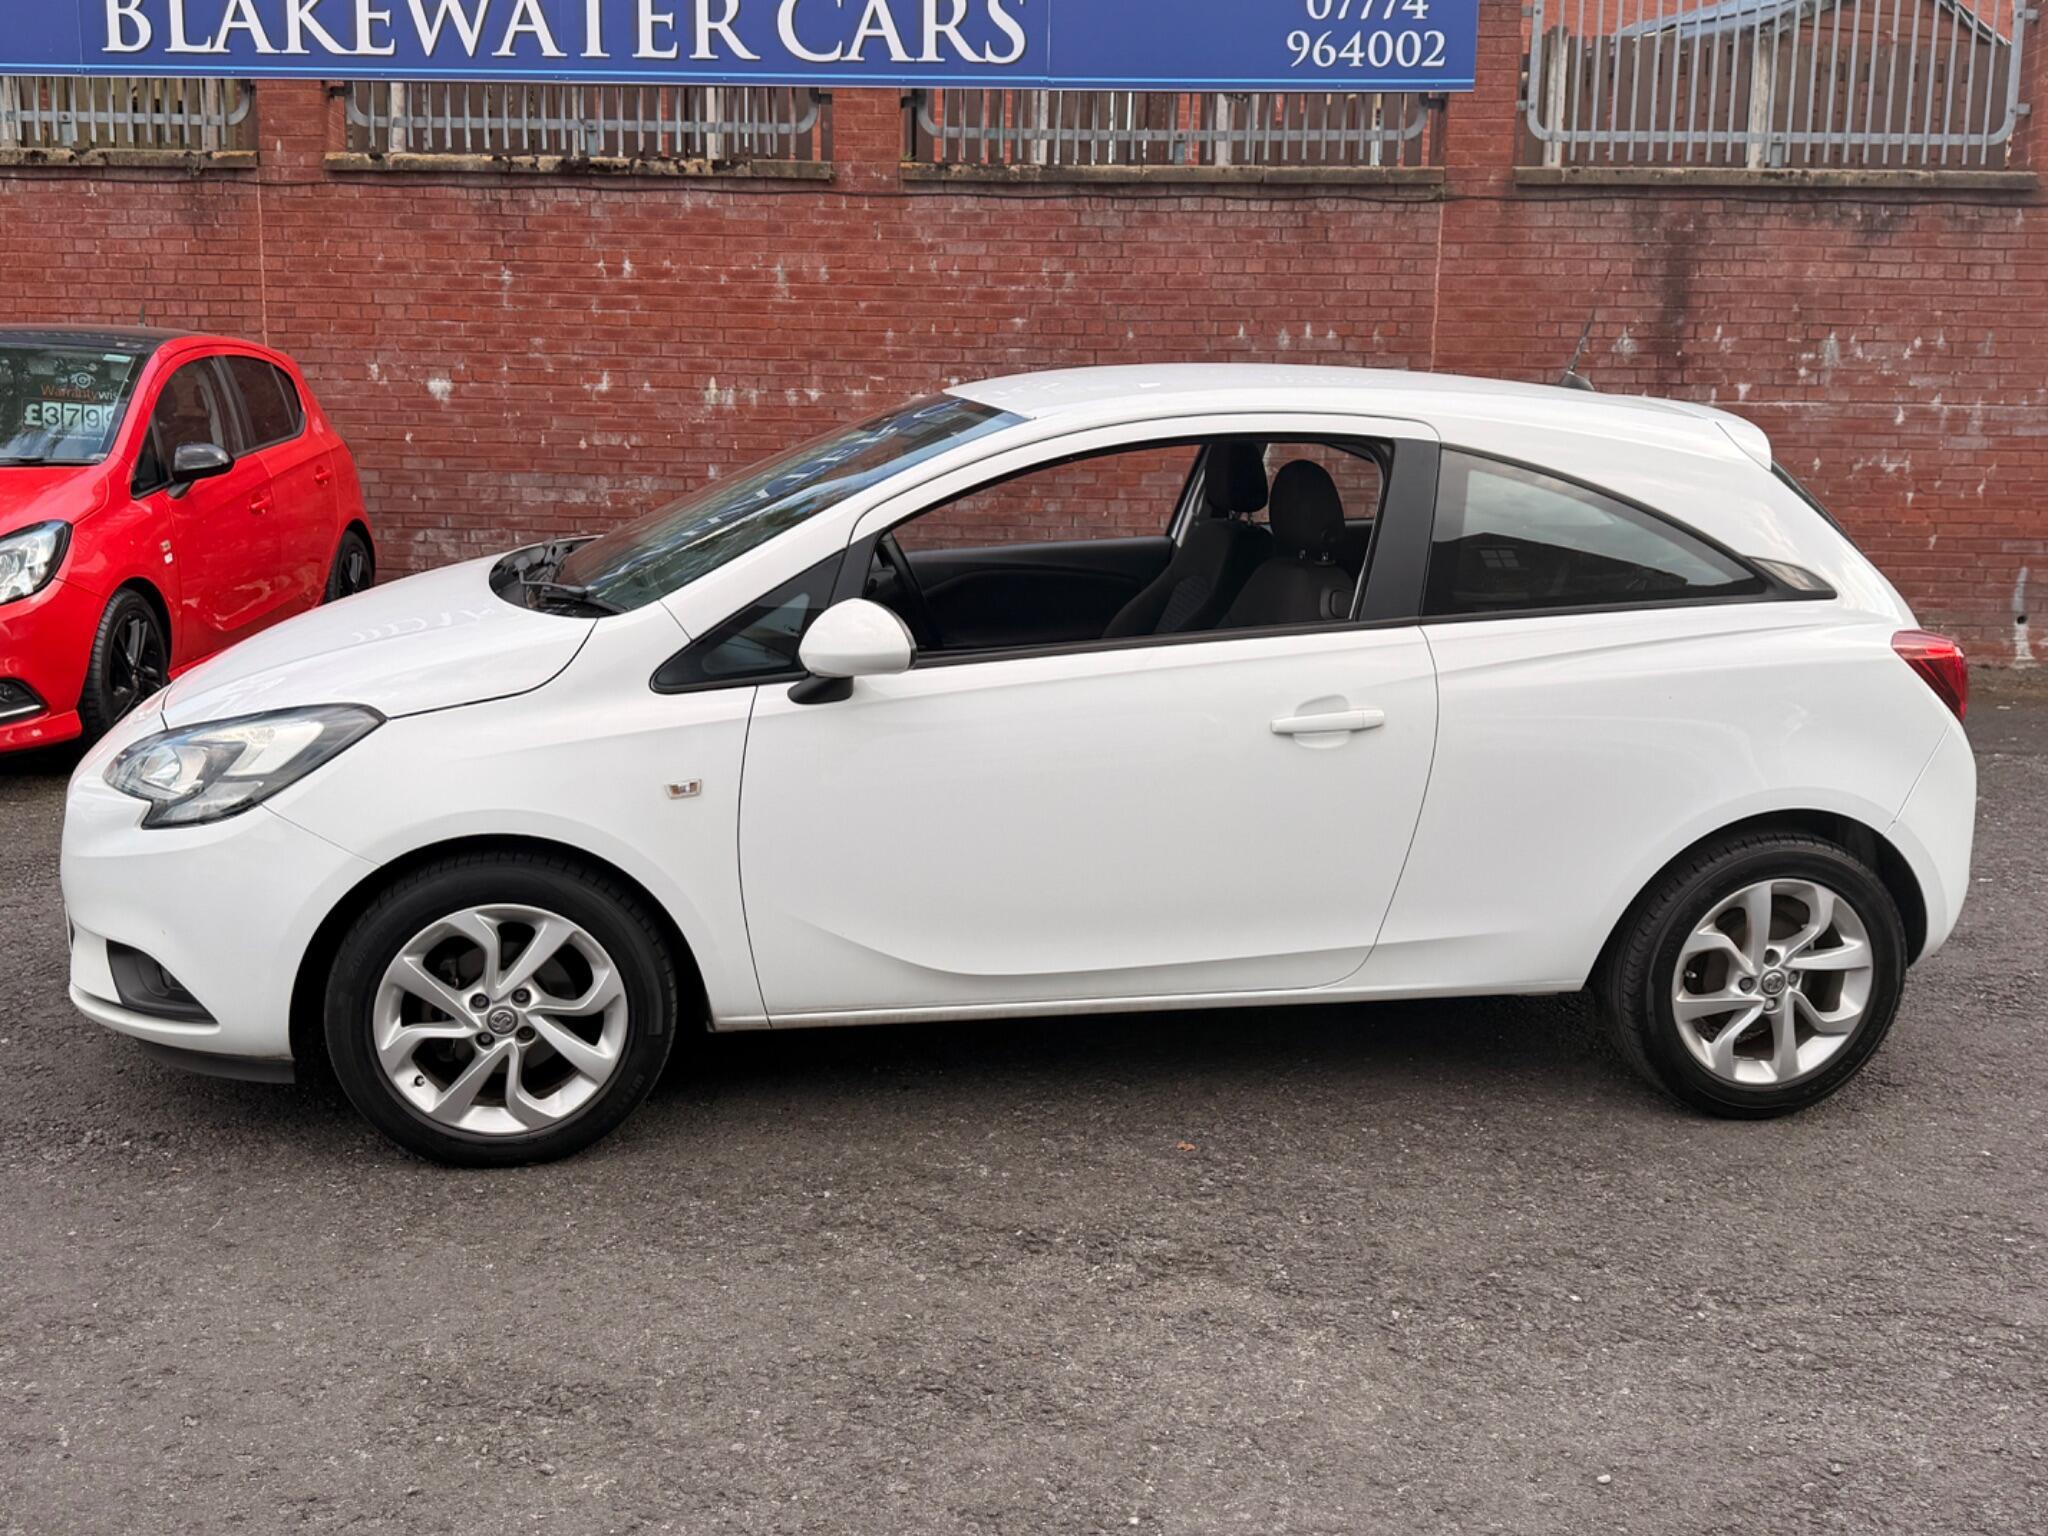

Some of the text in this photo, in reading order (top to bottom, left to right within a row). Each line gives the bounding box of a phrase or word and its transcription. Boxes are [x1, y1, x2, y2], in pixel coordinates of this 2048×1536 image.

[101, 0, 1026, 64] BLAKEWATER CARS
[1286, 30, 1446, 67] 964002
[41, 383, 118, 401] Warrantywis
